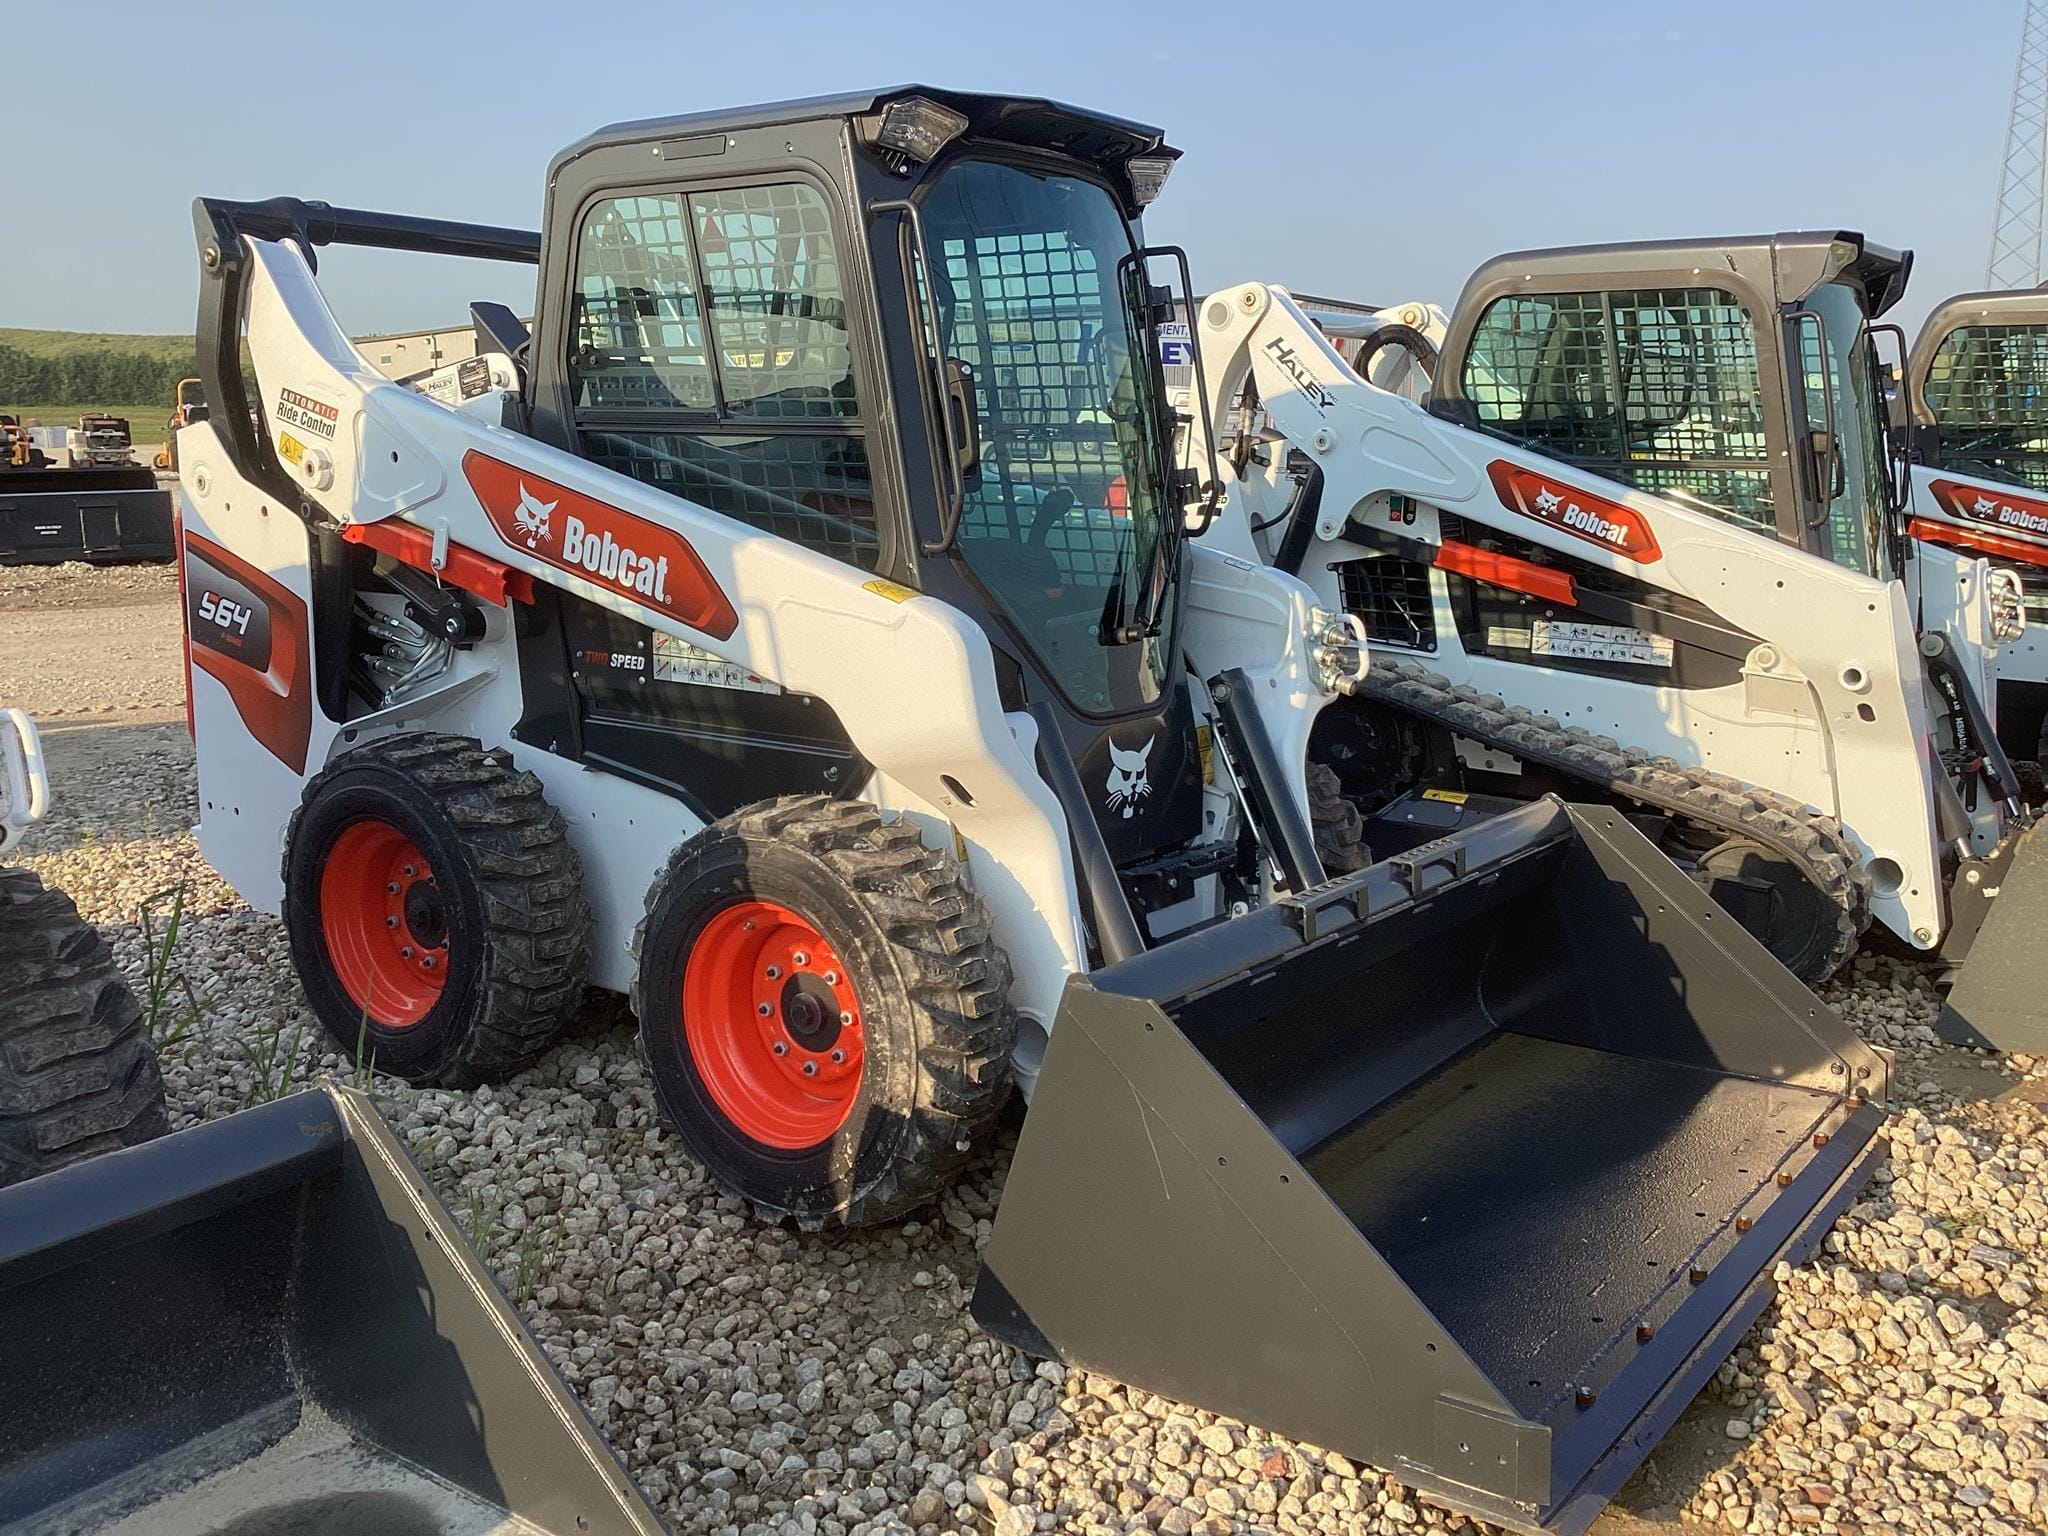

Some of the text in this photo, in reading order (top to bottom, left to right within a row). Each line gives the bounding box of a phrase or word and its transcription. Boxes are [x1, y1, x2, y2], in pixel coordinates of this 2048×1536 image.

[1265, 336, 1335, 408] HALEY
[276, 401, 336, 438] Ride Control
[281, 389, 337, 420] AUTOMATIC
[1999, 505, 2048, 532] Bobca
[198, 591, 252, 635] S64
[585, 650, 645, 670] TWO SPEED
